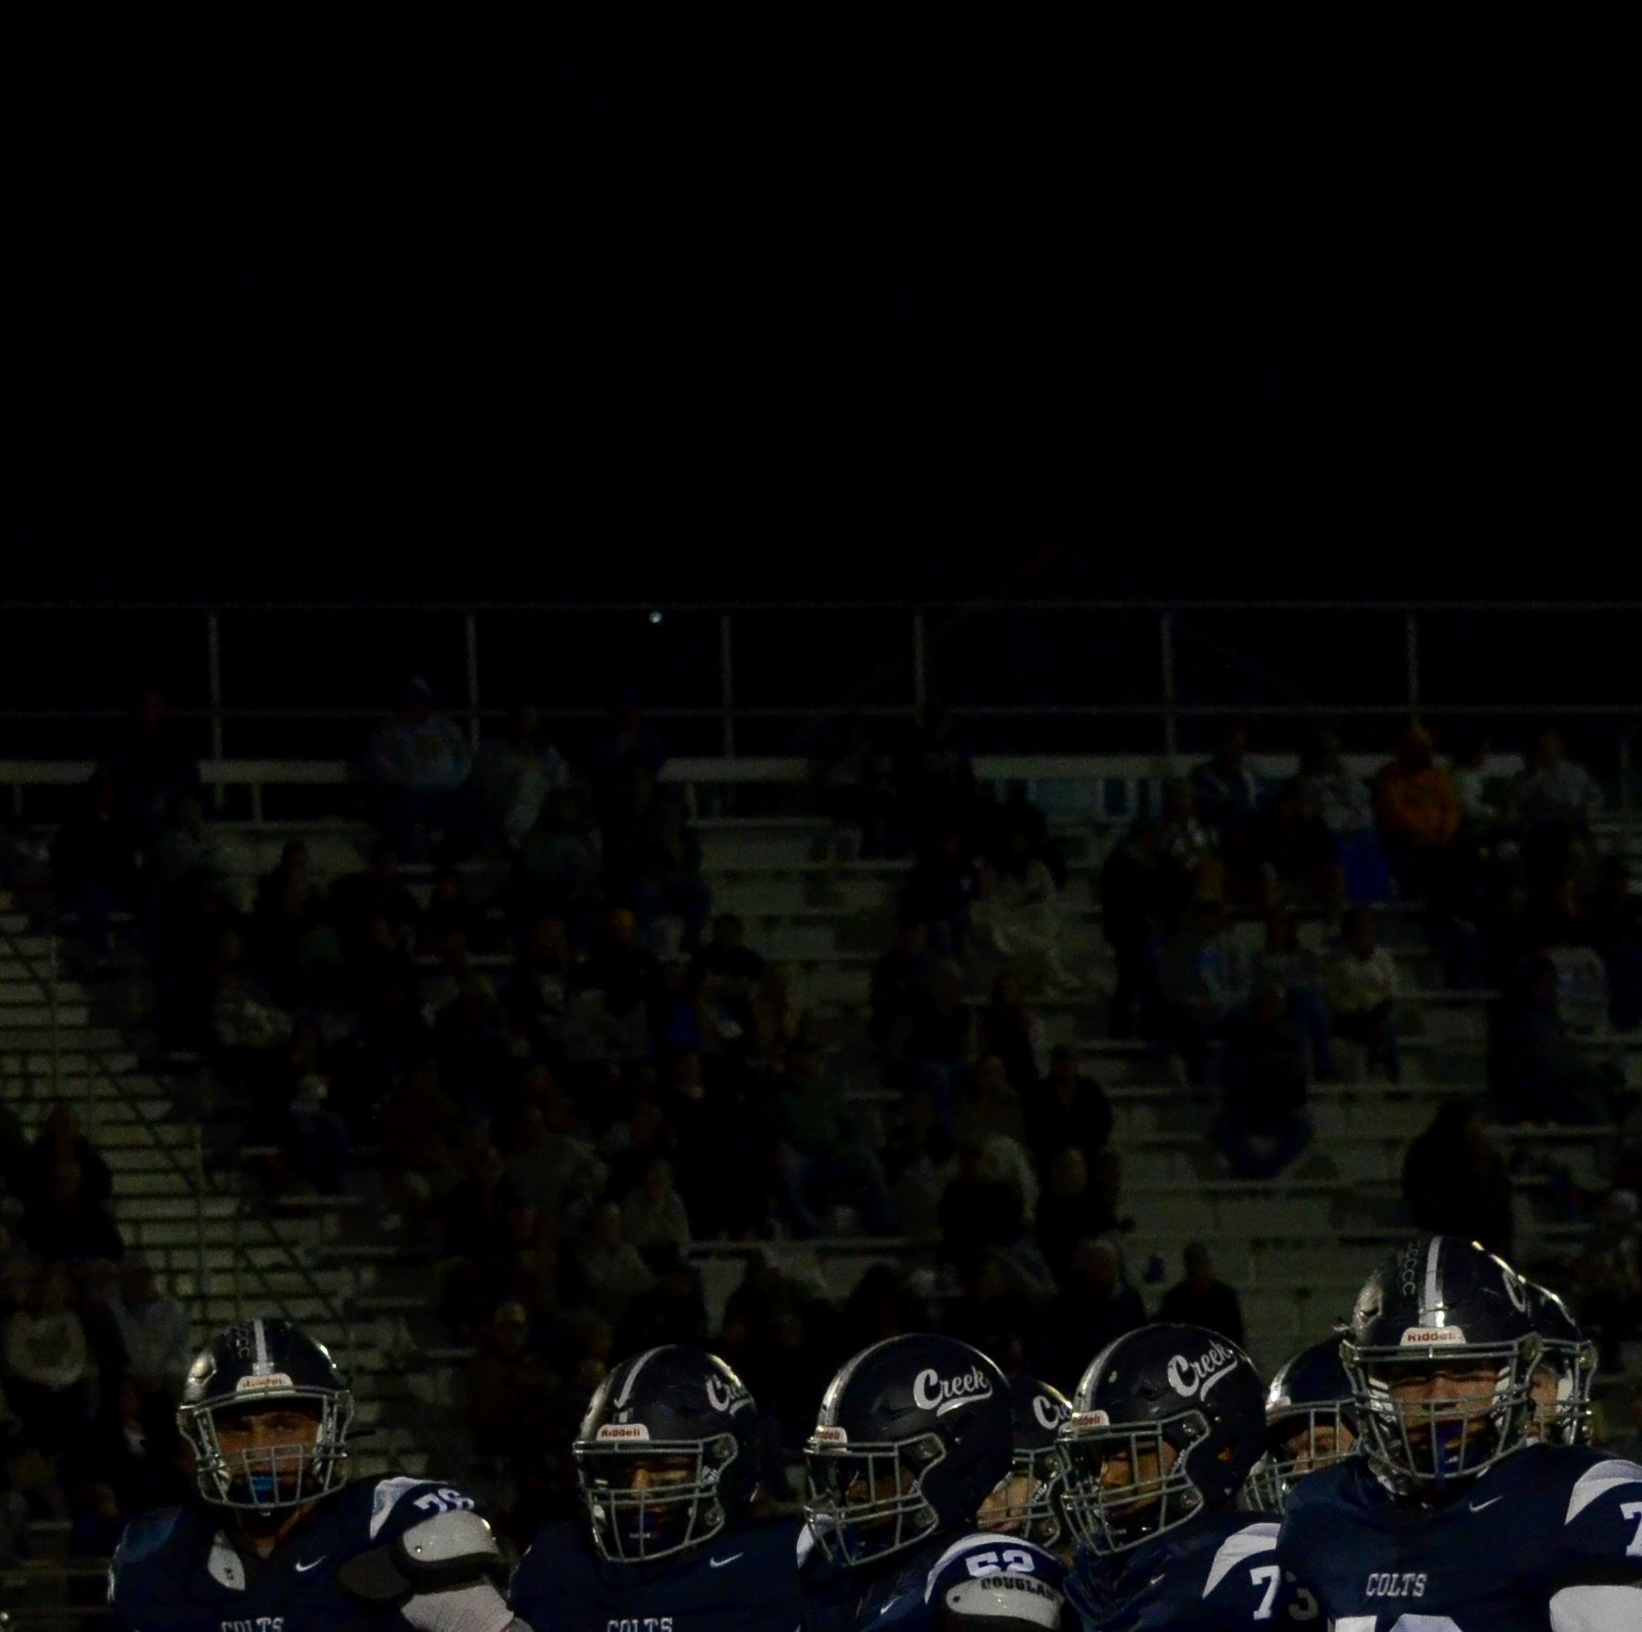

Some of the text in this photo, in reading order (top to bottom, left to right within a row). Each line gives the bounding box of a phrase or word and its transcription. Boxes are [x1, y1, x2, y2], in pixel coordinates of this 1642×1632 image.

[913, 1364, 994, 1417] Creek
[1167, 1339, 1239, 1402] Creek
[1365, 1572, 1428, 1598] COLTS
